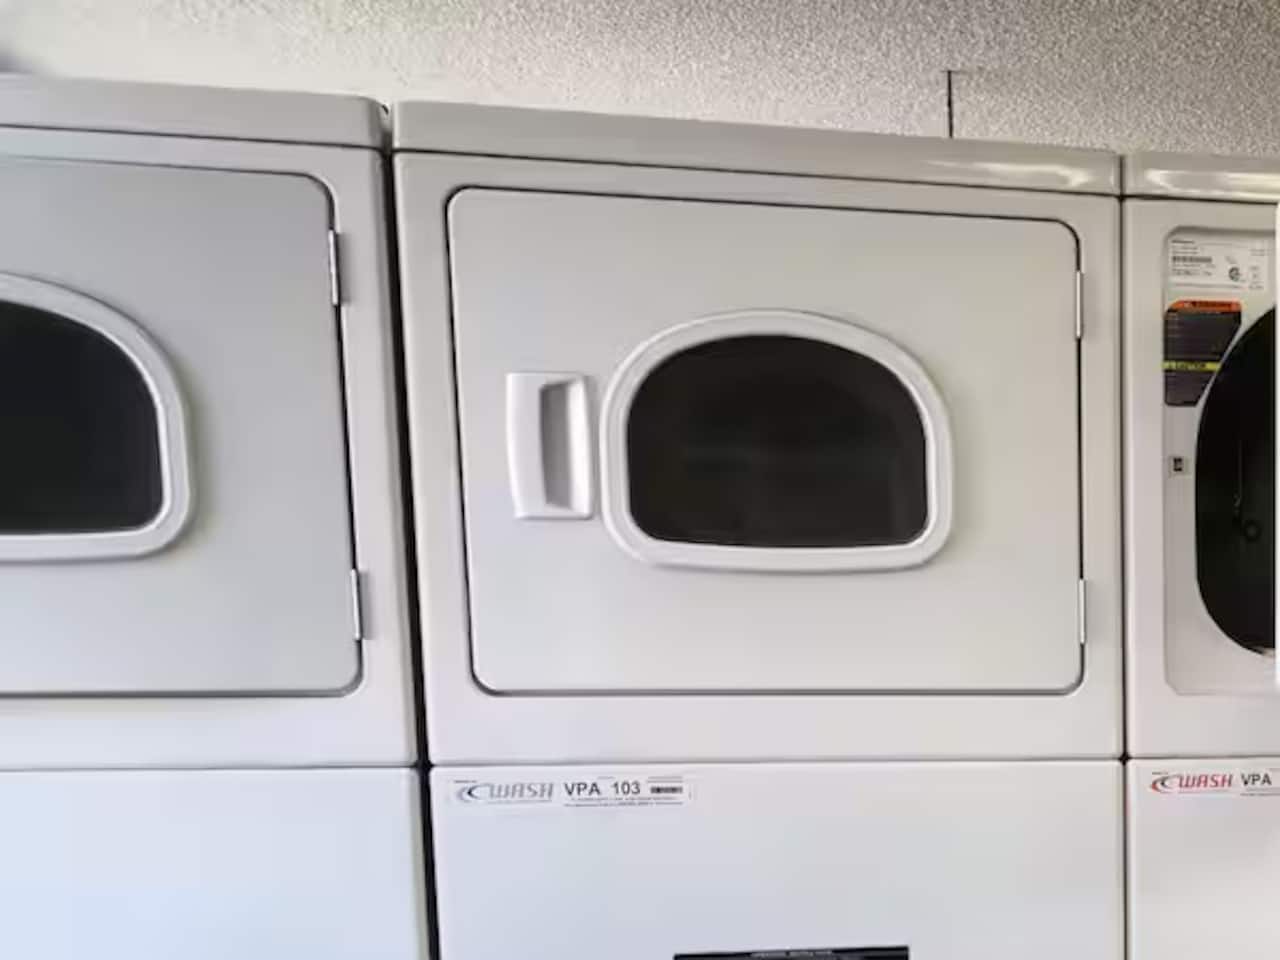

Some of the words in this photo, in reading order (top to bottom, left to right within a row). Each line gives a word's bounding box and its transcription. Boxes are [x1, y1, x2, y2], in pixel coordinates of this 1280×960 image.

[488, 781, 554, 799] WASH
[563, 781, 602, 797] VPA
[612, 780, 642, 796] 103
[1178, 773, 1233, 789] WASH
[1241, 773, 1272, 786] VPA
